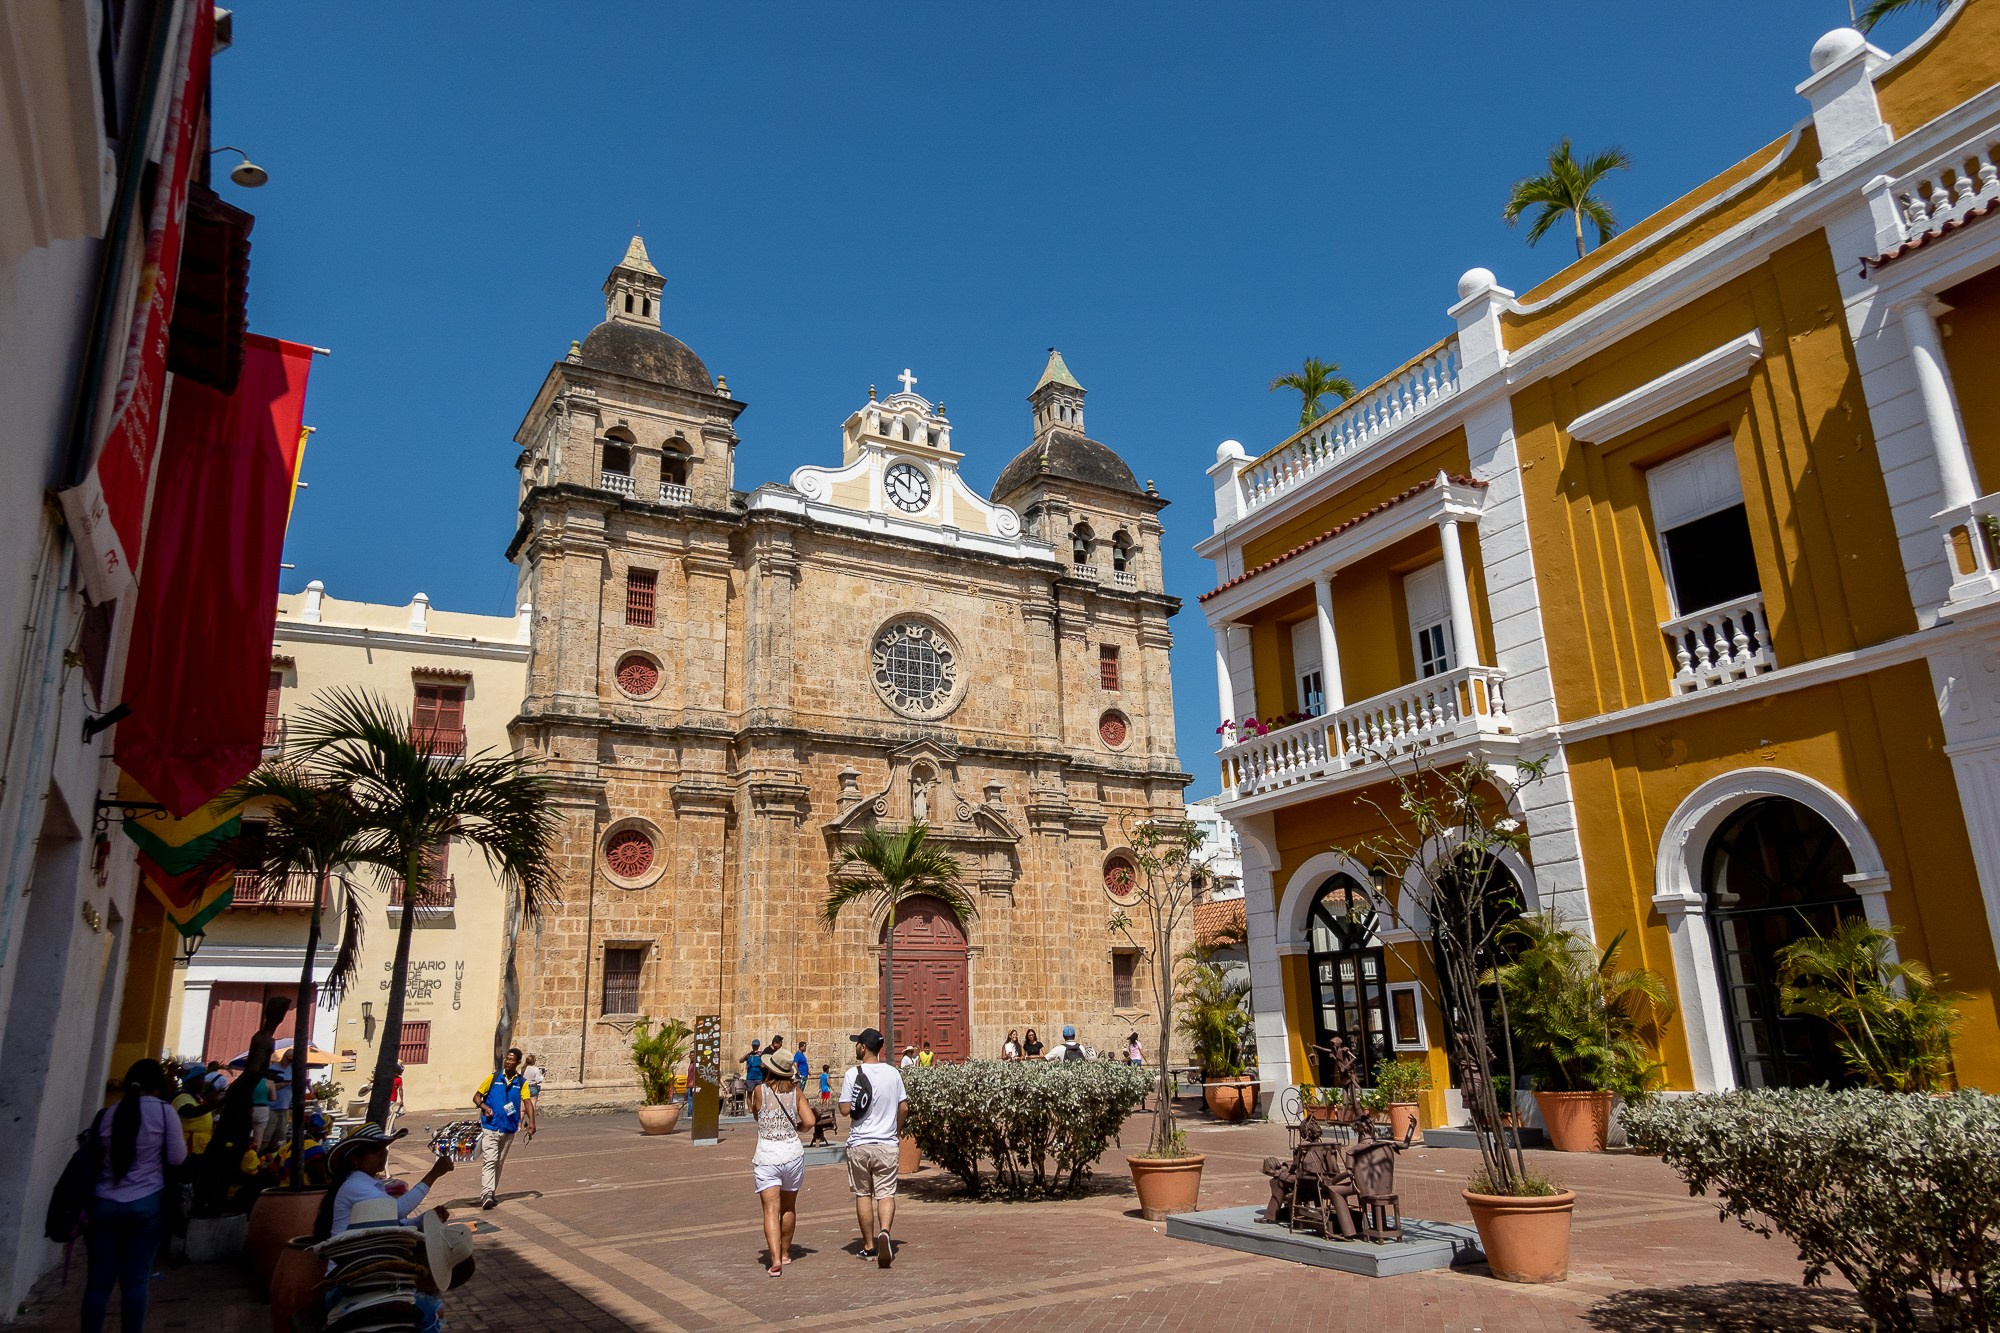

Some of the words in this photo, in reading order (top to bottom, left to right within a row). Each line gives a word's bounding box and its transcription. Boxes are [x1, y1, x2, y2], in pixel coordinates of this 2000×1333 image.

[384, 960, 446, 971] STUARIO
[407, 971, 422, 981] DE
[452, 960, 465, 1011] MUSEO
[404, 989, 432, 999] AVER
